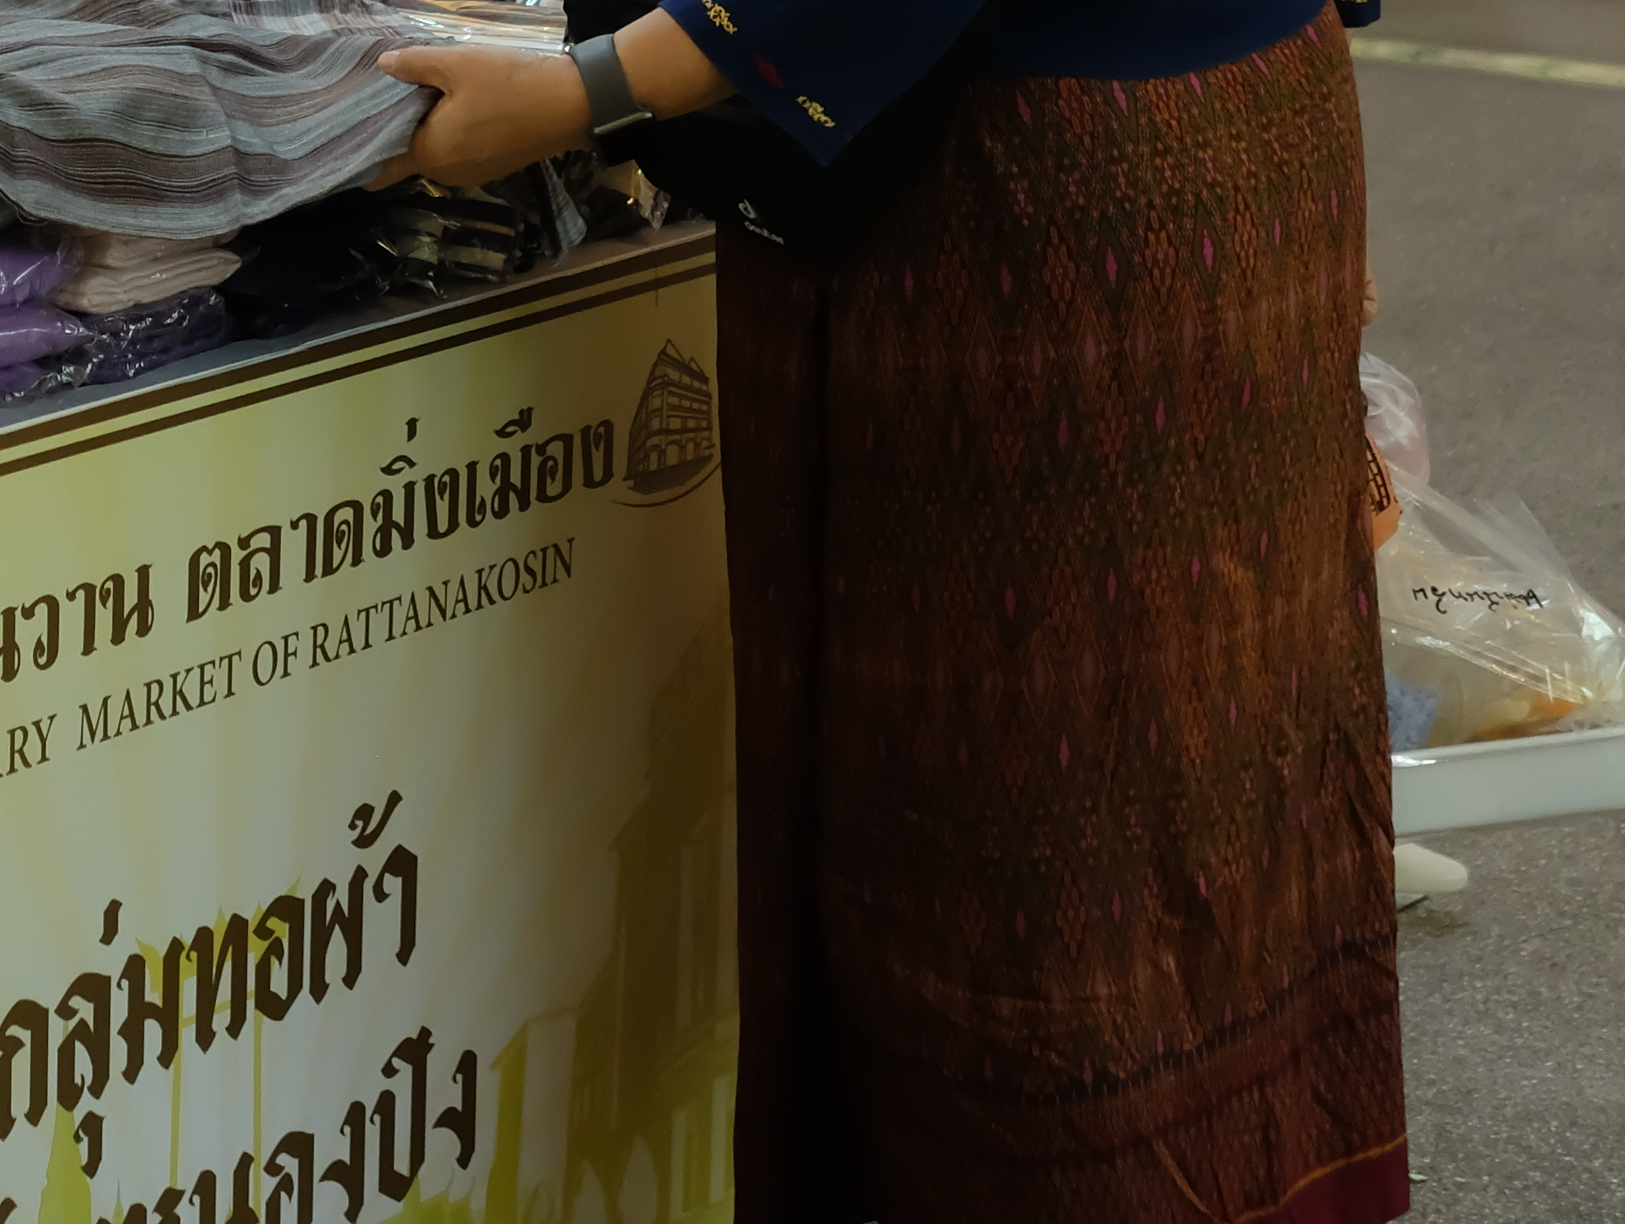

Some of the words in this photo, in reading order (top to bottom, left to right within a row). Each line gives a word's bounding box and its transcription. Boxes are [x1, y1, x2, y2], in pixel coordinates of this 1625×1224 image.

[185, 406, 614, 624] ตลาดมิ่งเมือง
[76, 649, 243, 752] MARKET
[252, 631, 300, 687] OF
[308, 537, 575, 669] RATTANAKOSIN
